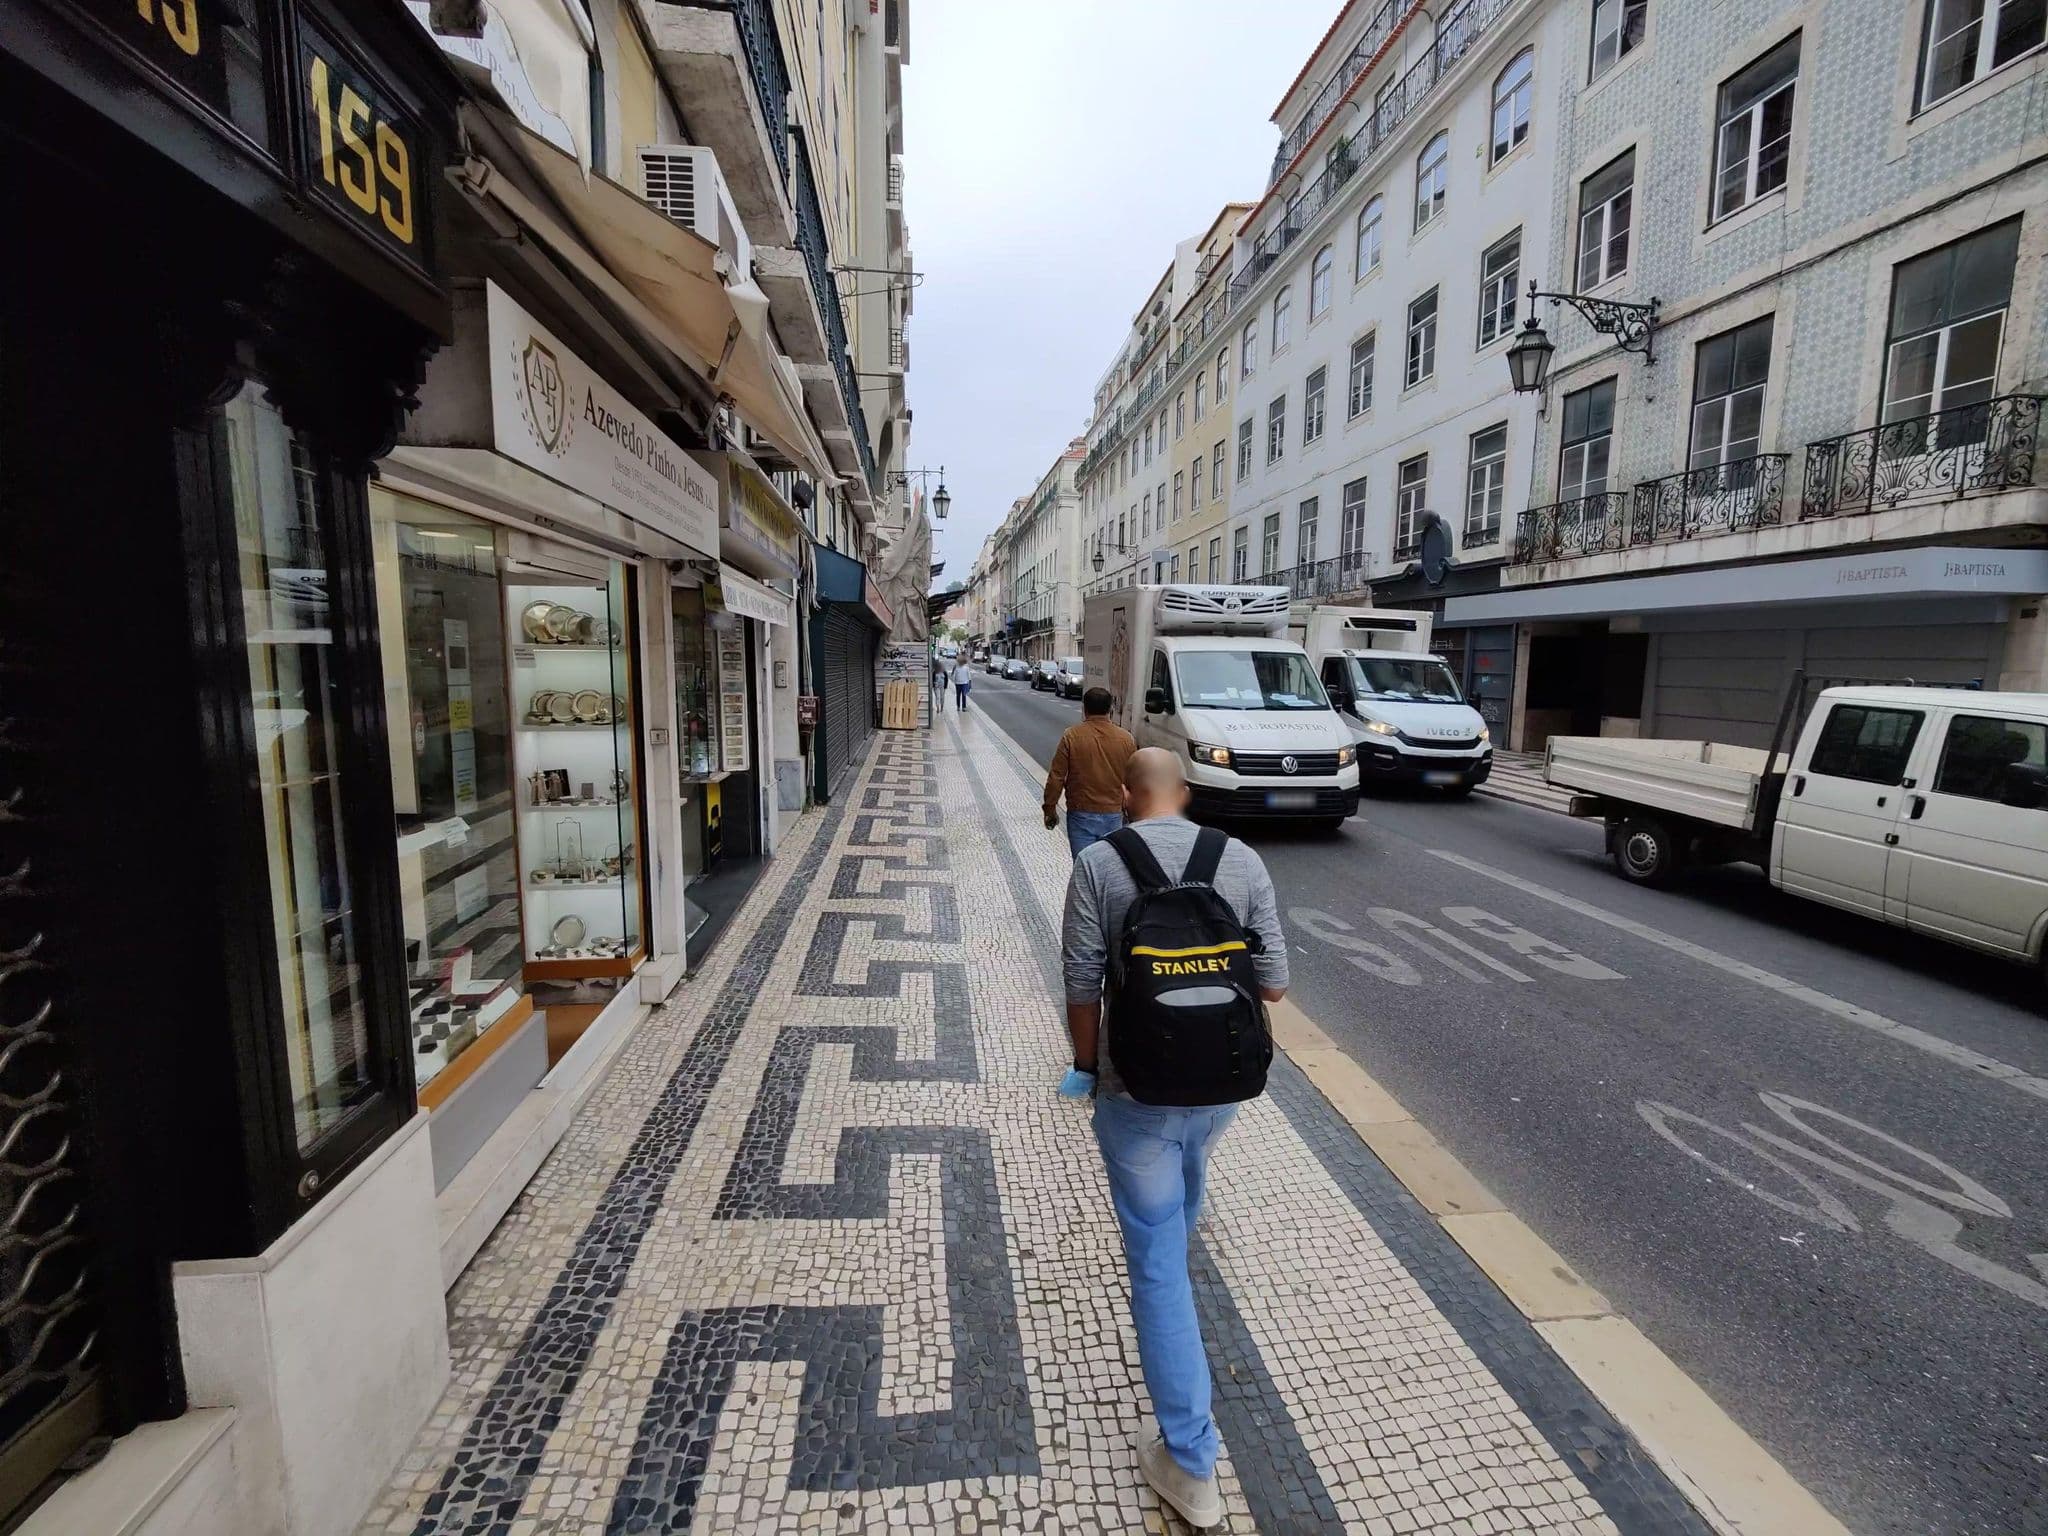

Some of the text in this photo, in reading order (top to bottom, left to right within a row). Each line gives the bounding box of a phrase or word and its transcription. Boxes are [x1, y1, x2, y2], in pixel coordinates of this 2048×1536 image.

[310, 56, 414, 245] 159
[584, 384, 643, 460] Azevedo
[645, 435, 677, 485] Pinho
[1241, 722, 1331, 733] EUROPASTRY
[1426, 727, 1460, 737] IVECO
[1151, 956, 1230, 976] STANLEY
